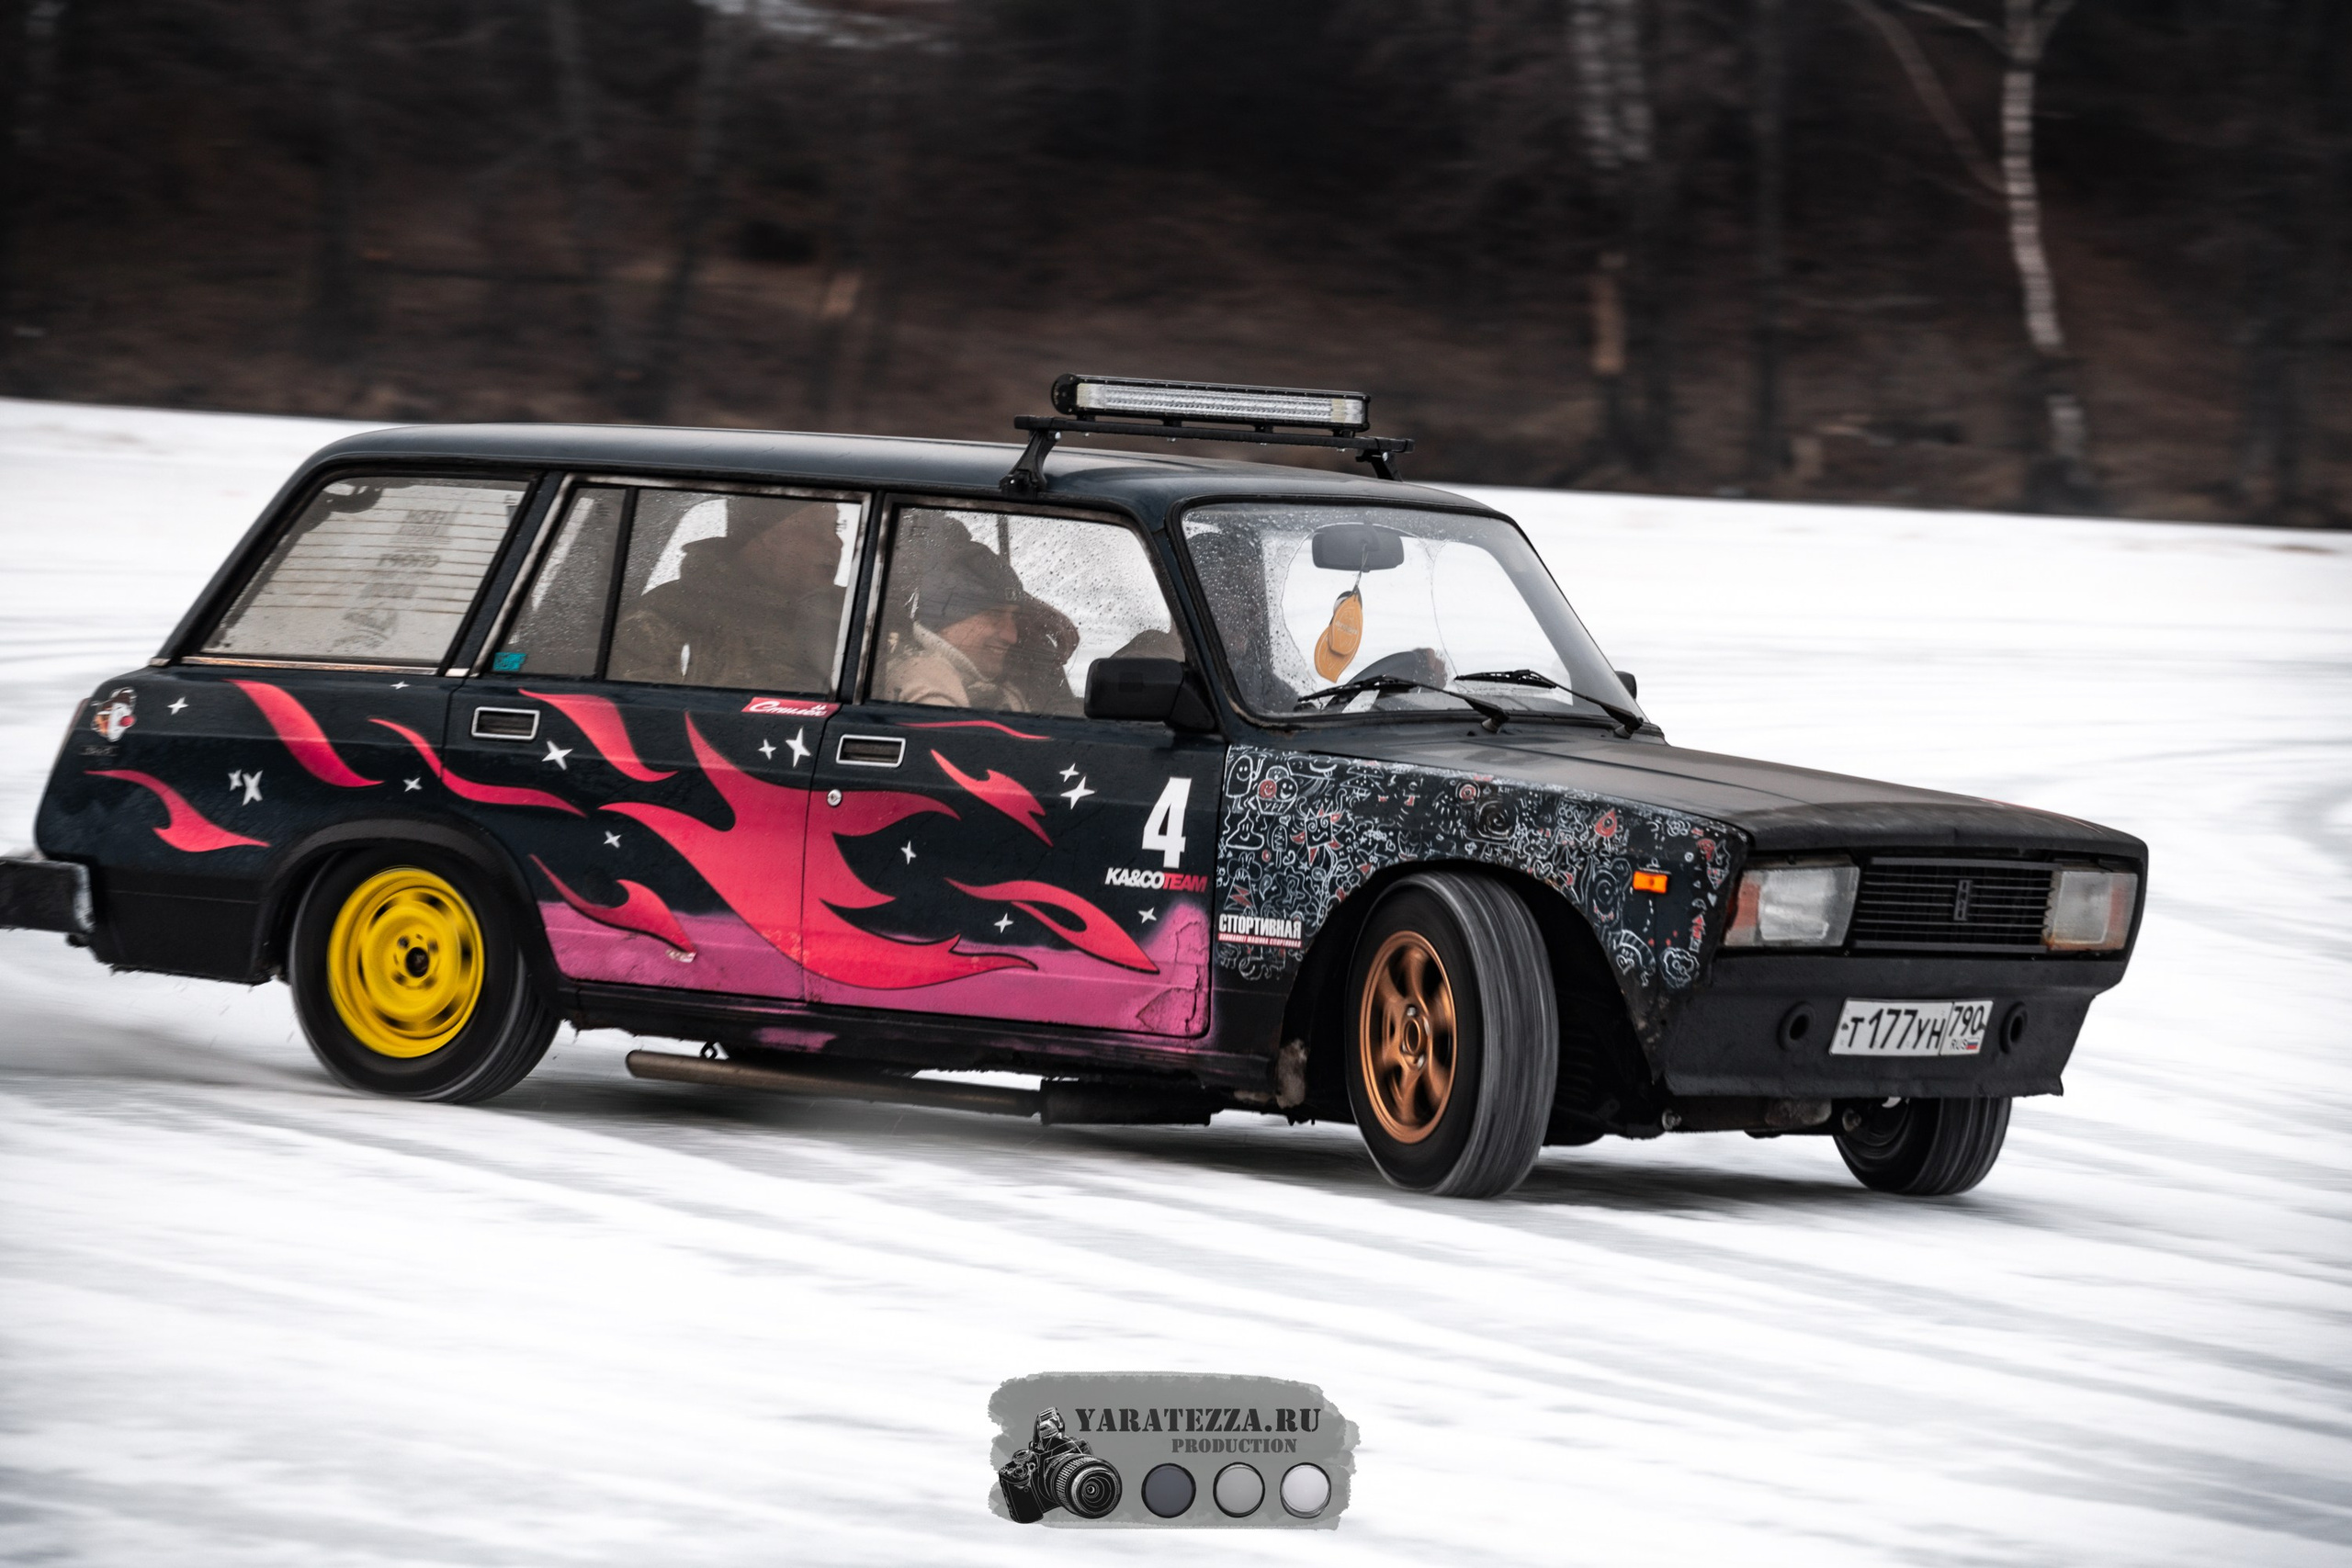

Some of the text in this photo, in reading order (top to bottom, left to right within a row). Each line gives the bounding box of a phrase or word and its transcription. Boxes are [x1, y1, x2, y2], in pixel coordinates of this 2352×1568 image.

[1141, 776, 1193, 869] 4
[1848, 1005, 1985, 1050] Т177УН 790
[1951, 1038, 1968, 1050] RUS
